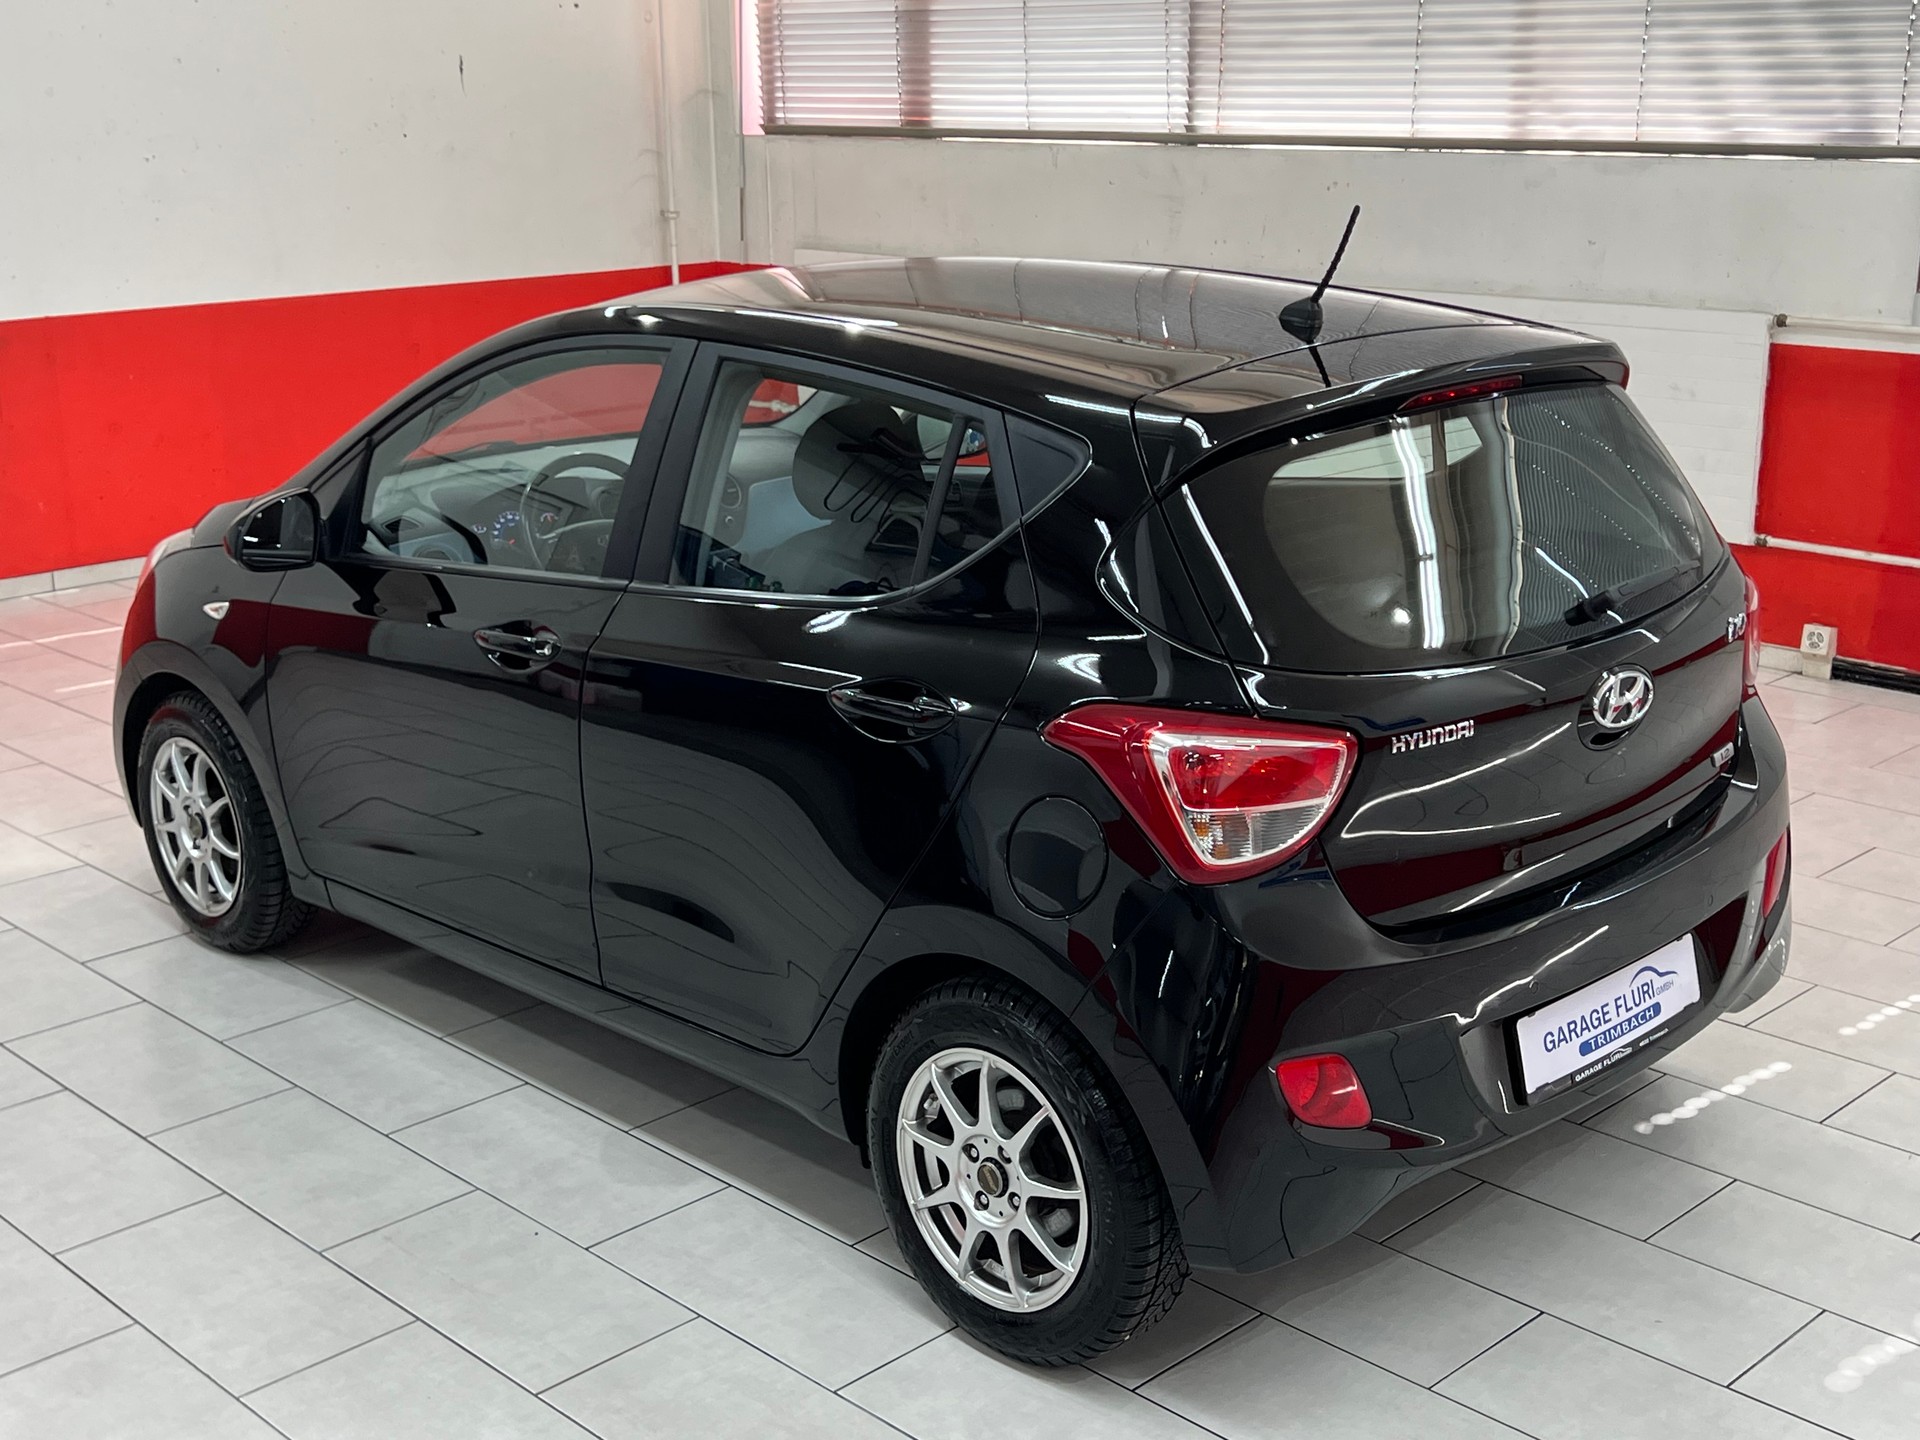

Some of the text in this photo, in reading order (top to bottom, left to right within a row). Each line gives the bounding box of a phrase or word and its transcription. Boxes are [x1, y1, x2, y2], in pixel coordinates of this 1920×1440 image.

[1391, 719, 1475, 754] HYUNDAI
[1543, 1002, 1612, 1053] GARAGE
[1614, 979, 1656, 1018] FLURI
[1588, 1006, 1655, 1051] TRIMBACH
[1575, 1062, 1603, 1082] GARAGE
